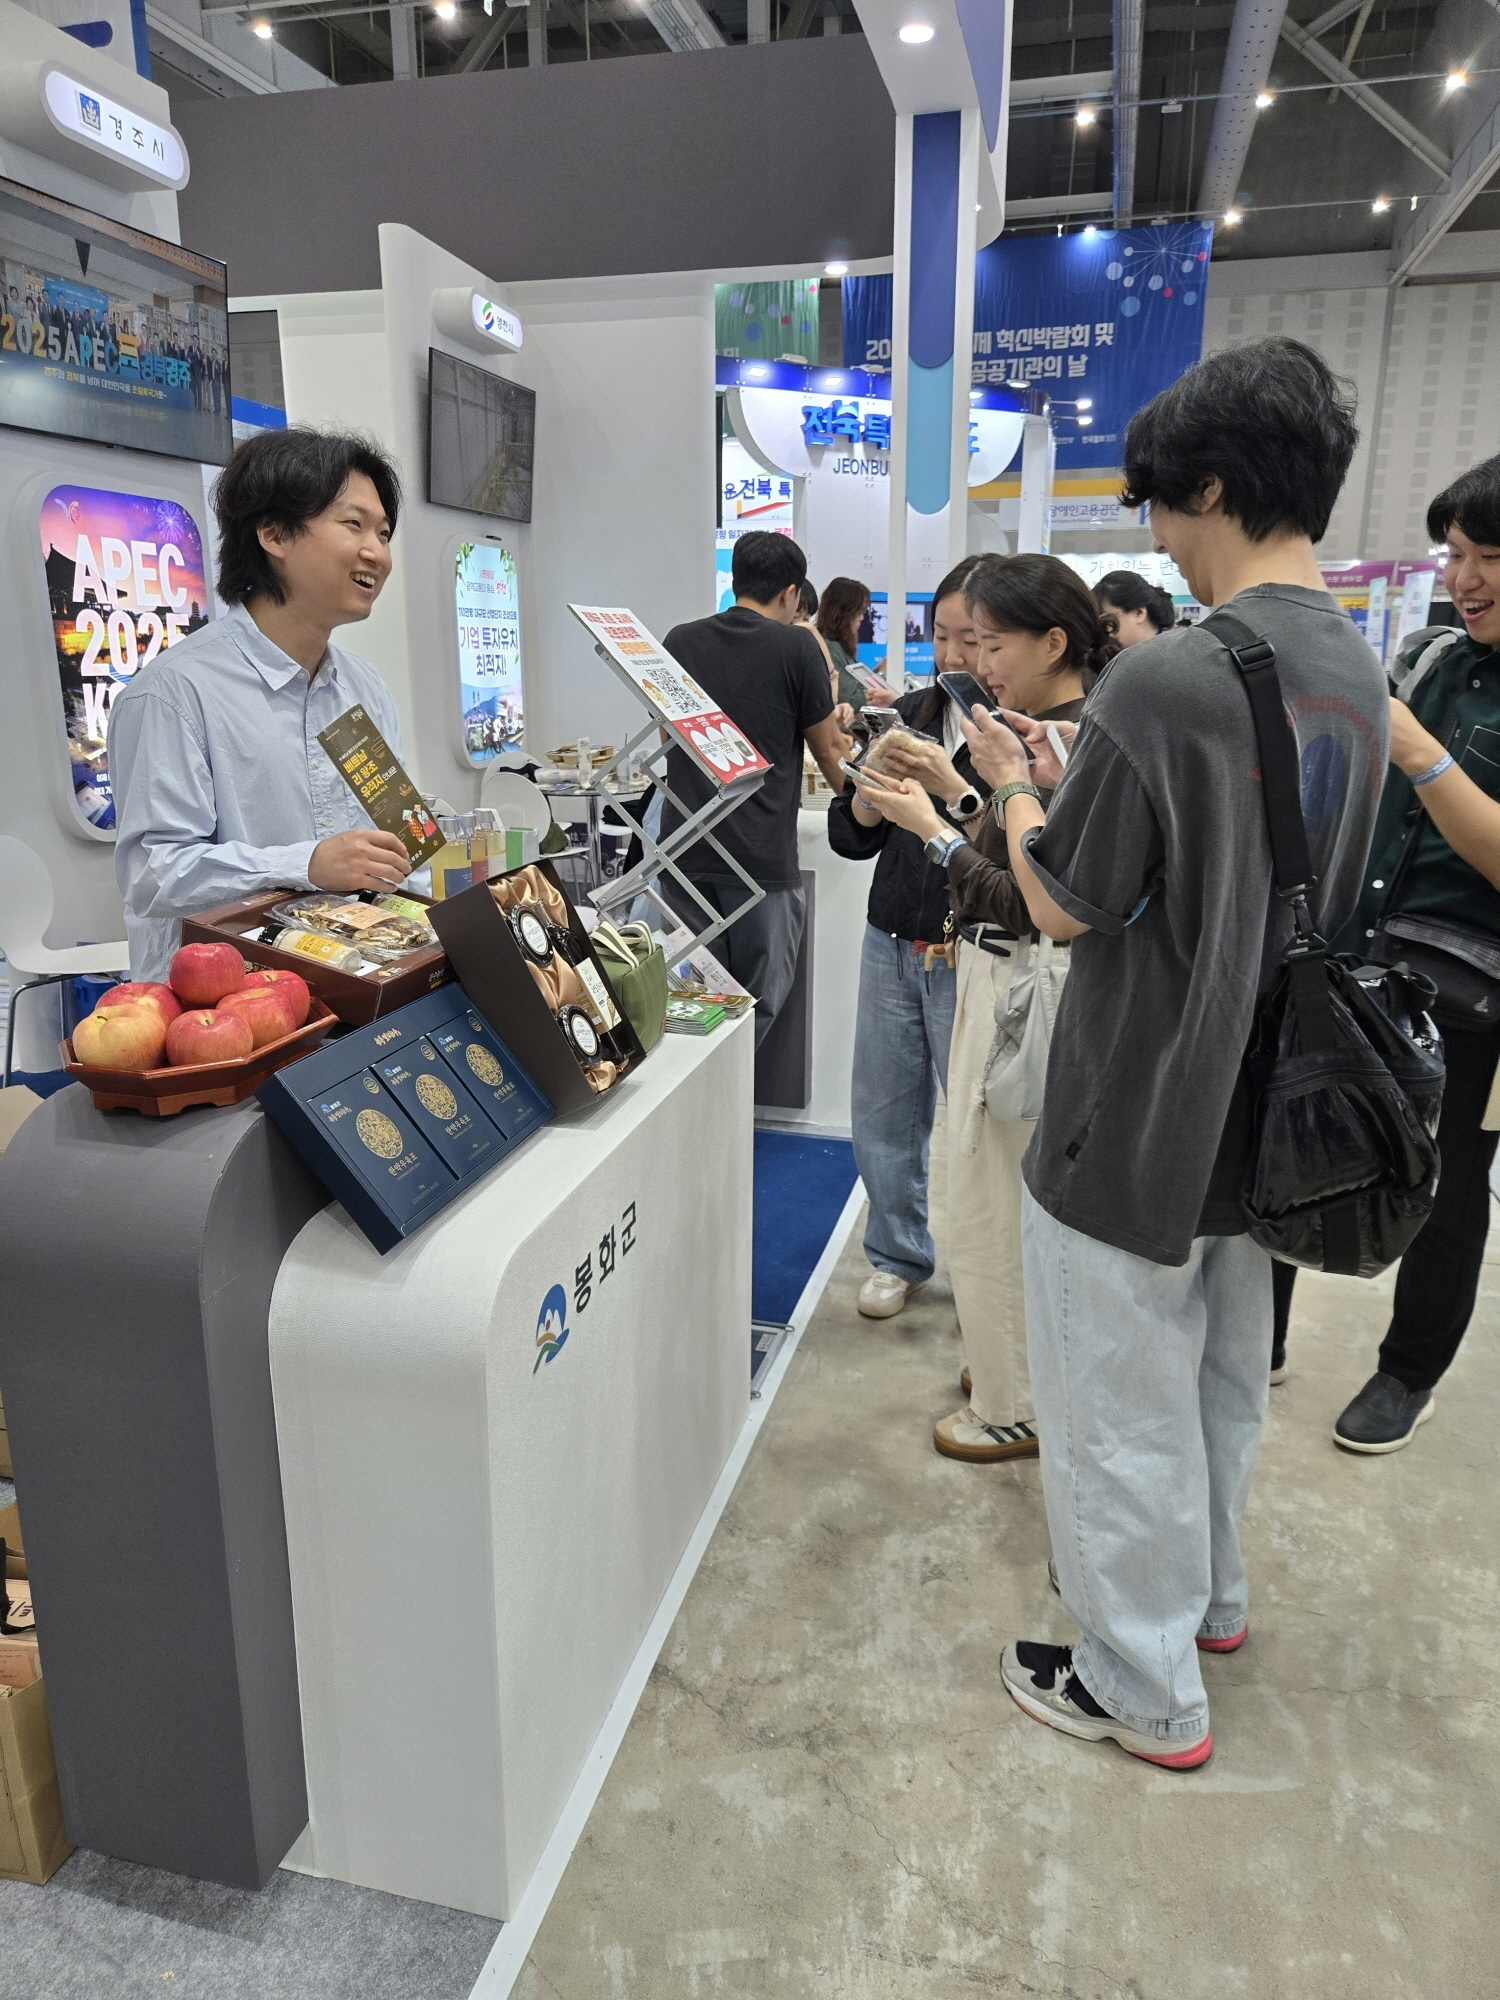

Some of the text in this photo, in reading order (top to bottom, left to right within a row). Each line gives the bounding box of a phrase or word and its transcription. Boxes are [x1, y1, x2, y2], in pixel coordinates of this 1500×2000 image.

[108, 114, 164, 161] 경주시
[497, 316, 514, 336] 영천시
[865, 339, 892, 361] 20
[996, 324, 1091, 353] 혁신박람회
[1095, 322, 1114, 347] 및
[972, 354, 1088, 385] 공공기관의 날
[801, 400, 892, 450] 전북특
[72, 534, 187, 608] APEC
[459, 626, 519, 650] 기업 투자유치
[476, 653, 507, 677] 최적지!
[343, 749, 368, 773] 베트남
[351, 760, 378, 786] 리 왕조
[360, 774, 385, 799] 유적지
[574, 1200, 636, 1314] 봉화군
